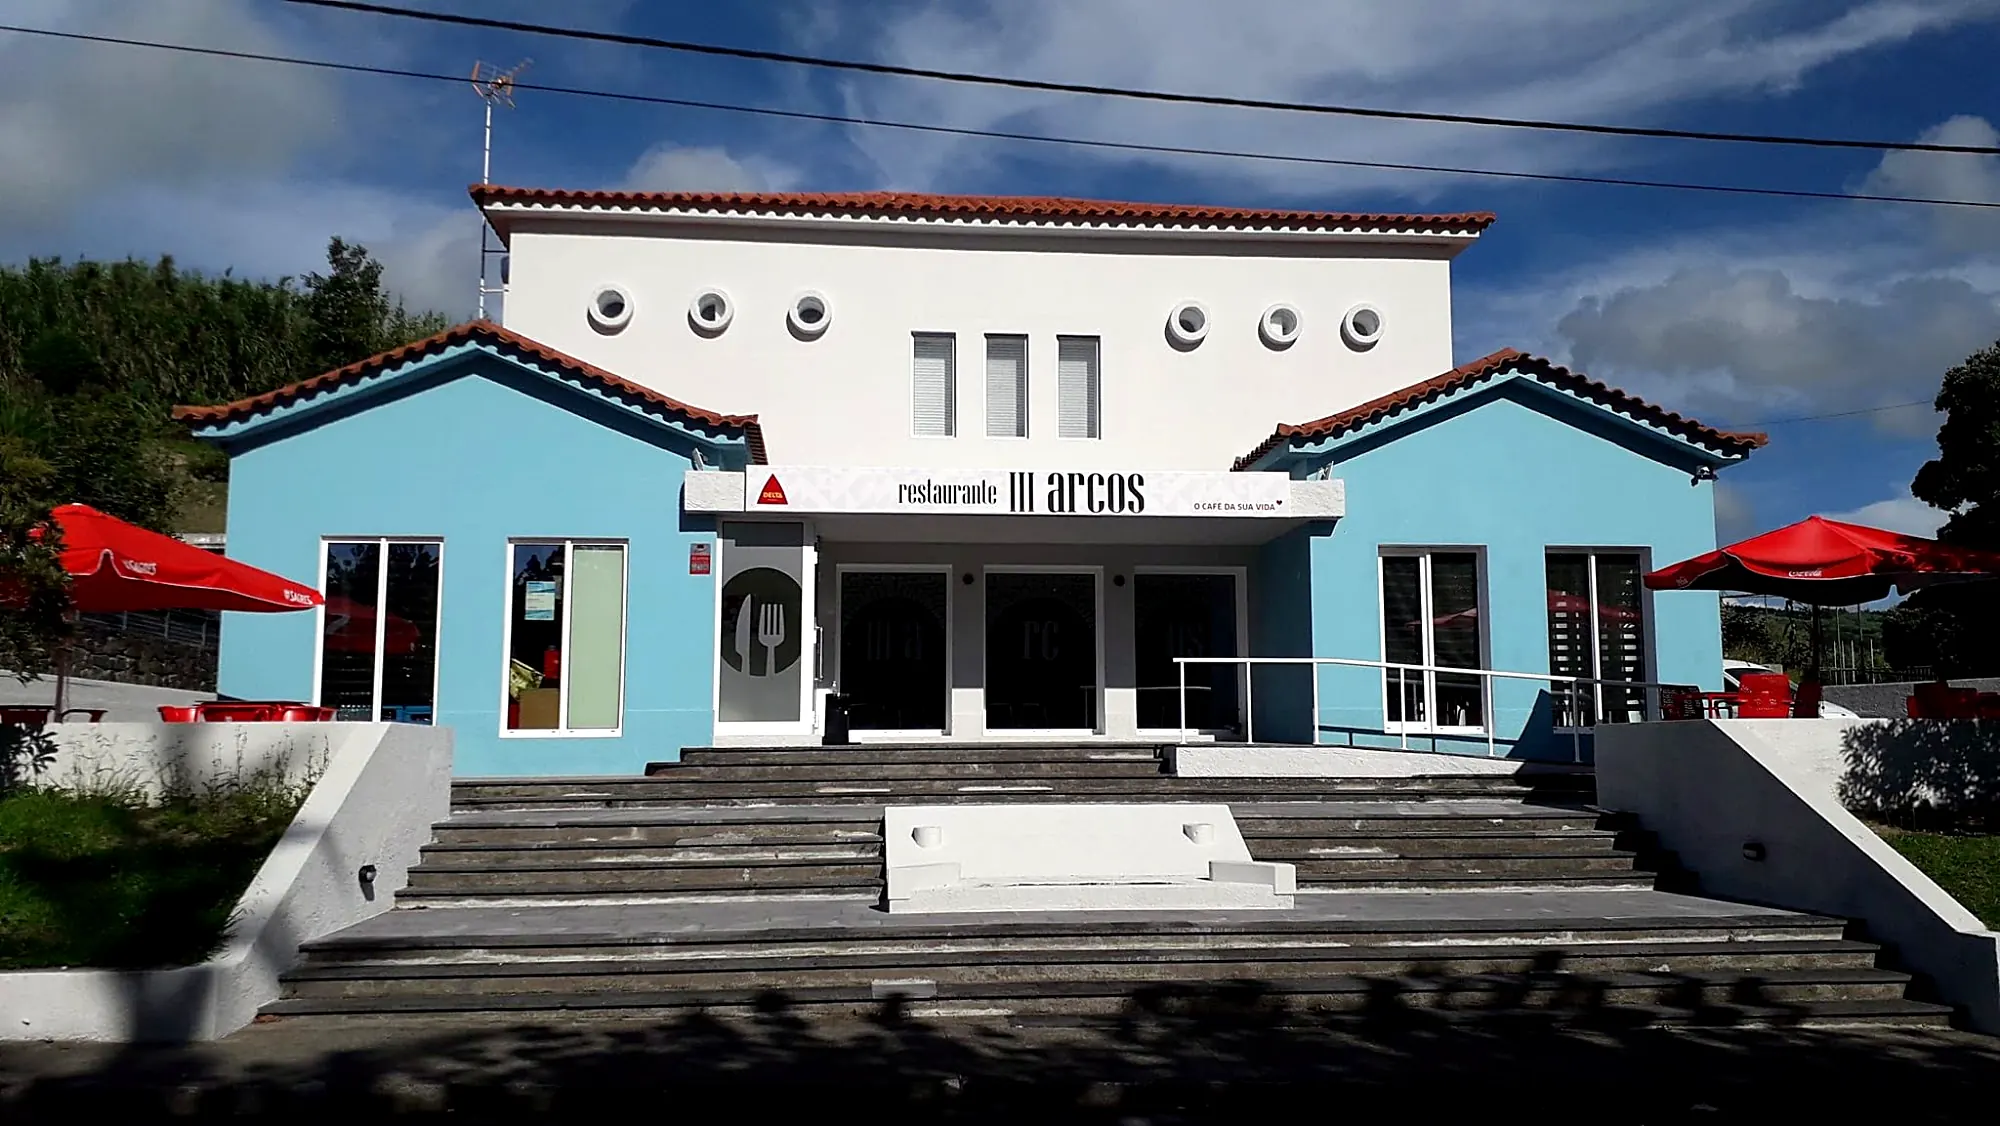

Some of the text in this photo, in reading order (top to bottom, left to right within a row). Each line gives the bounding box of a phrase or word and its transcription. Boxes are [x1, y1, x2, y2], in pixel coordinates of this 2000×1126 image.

[898, 479, 997, 504] restaurante
[1047, 472, 1145, 513] arcos
[1237, 503, 1254, 511] SUA
[1256, 503, 1276, 511] VIDA
